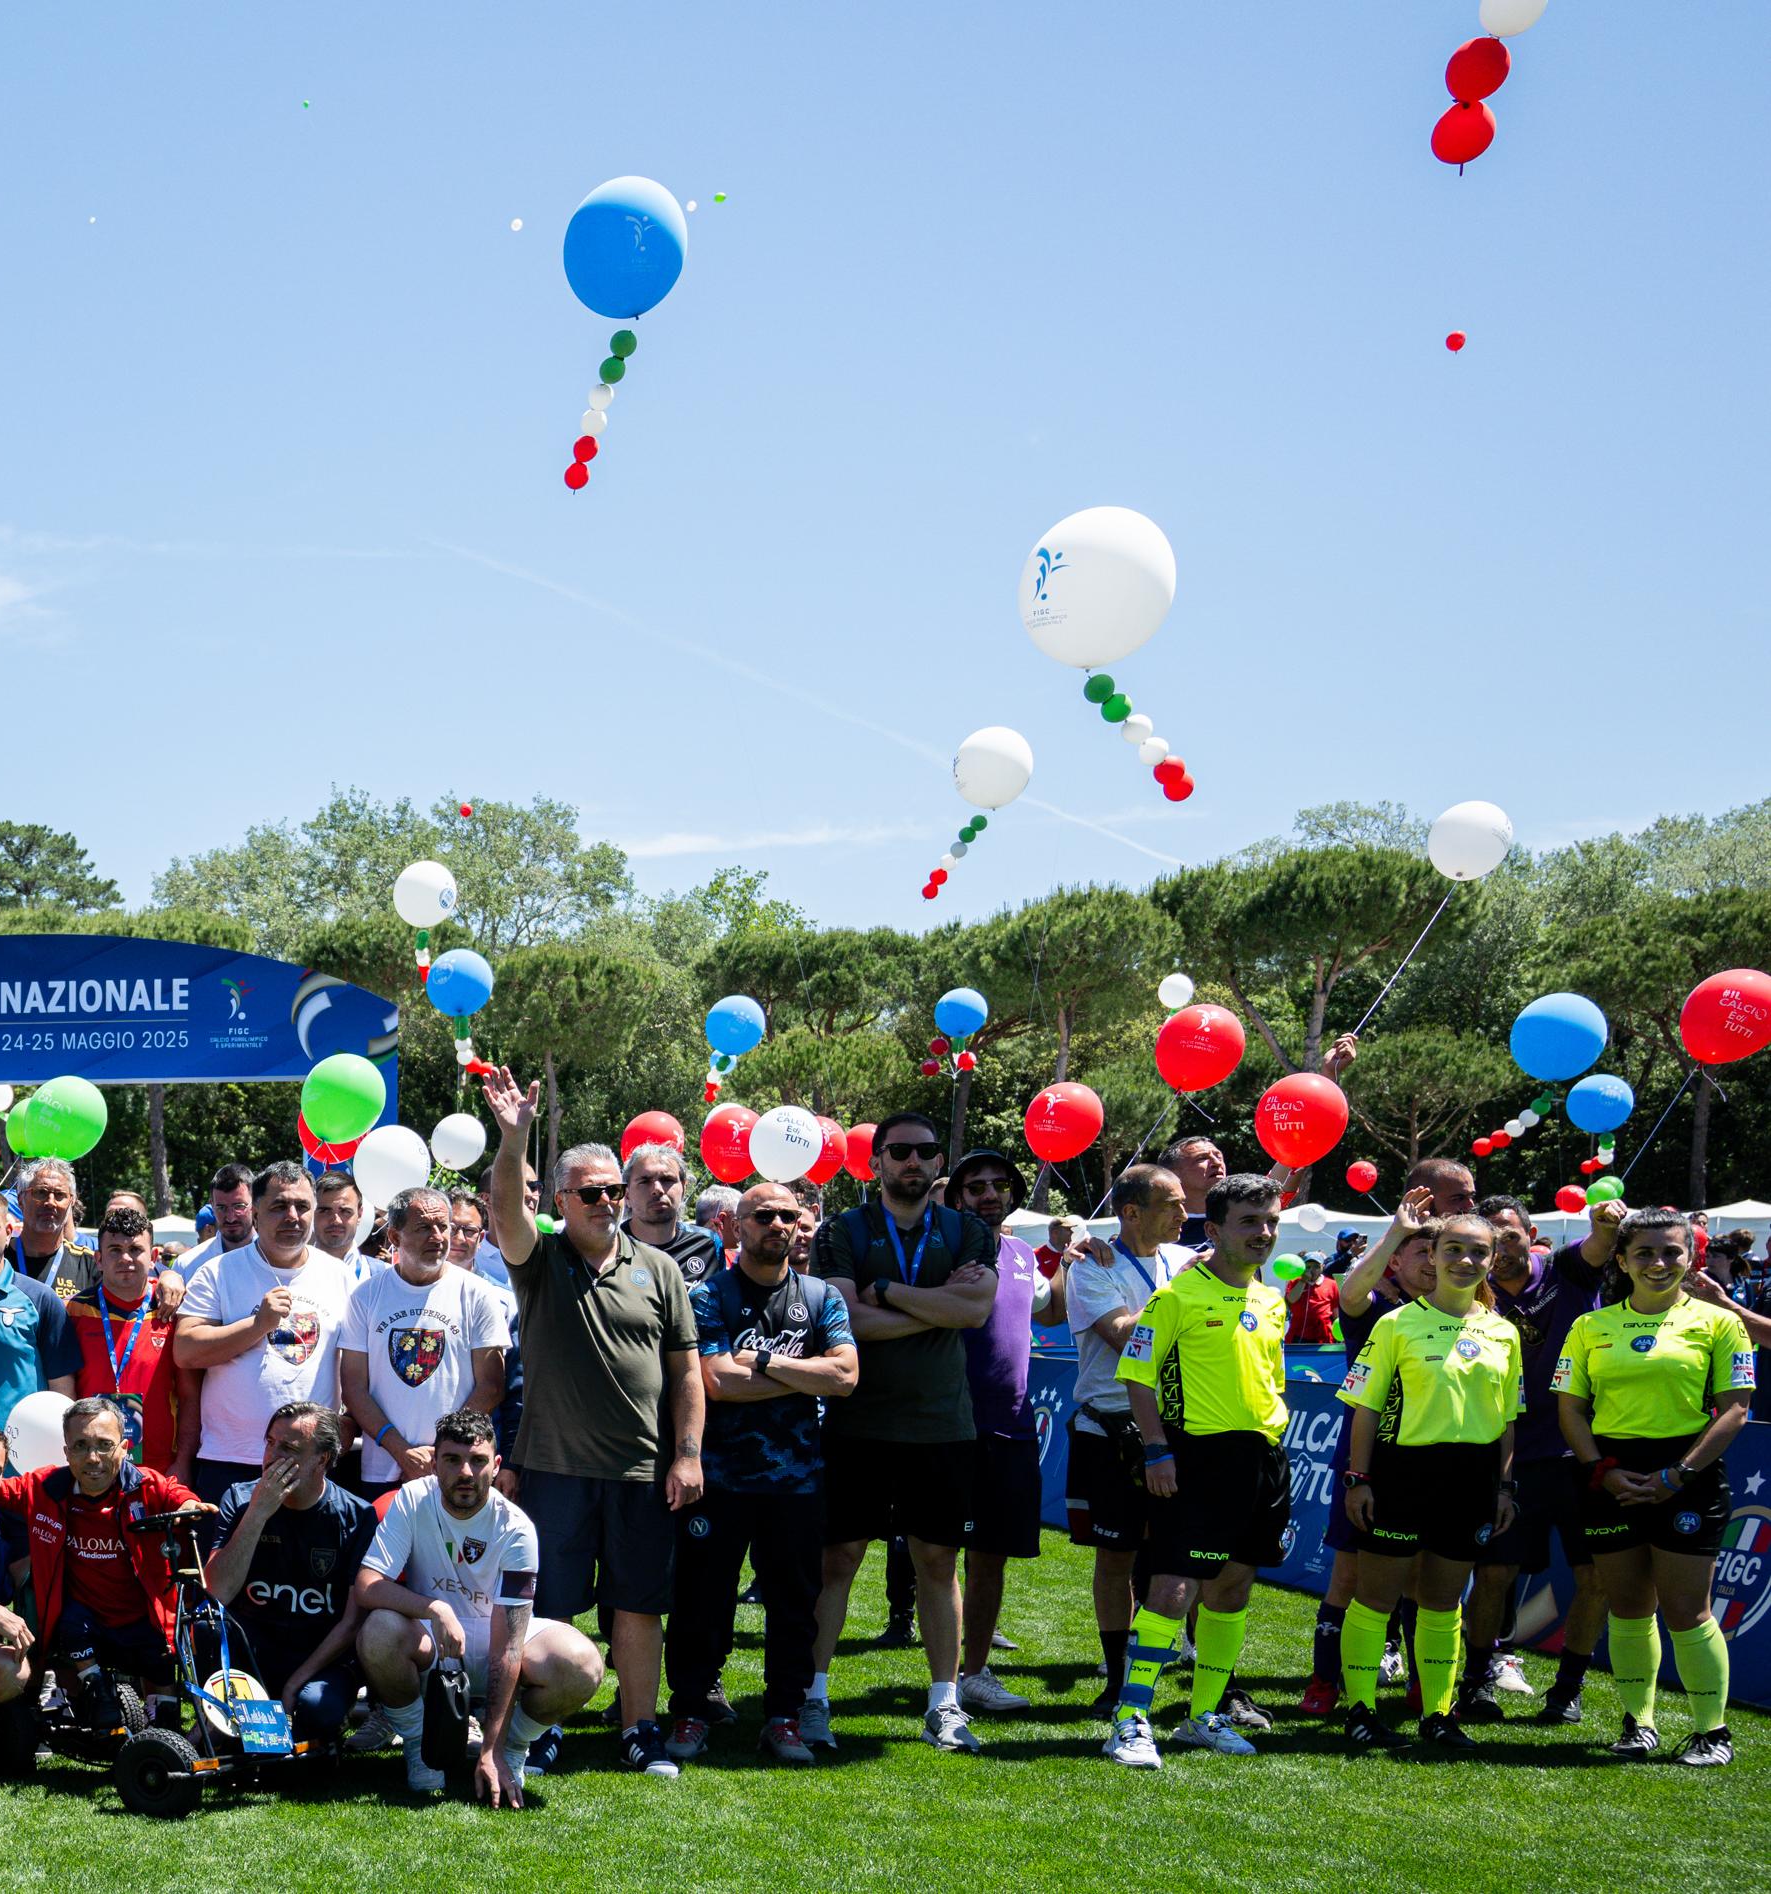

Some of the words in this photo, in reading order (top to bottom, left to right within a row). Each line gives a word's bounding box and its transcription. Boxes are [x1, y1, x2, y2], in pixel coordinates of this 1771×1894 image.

[0, 977, 190, 1014] NAZIONALE
[1722, 988, 1742, 1001] #IL
[1724, 1020, 1754, 1039] TUTTI
[2, 1032, 54, 1051] 24-25
[61, 1031, 135, 1050] MAGGIO
[141, 1029, 189, 1048] 2025
[1274, 1121, 1305, 1132] TUTTI
[784, 1133, 810, 1149] TUTTI
[56, 1277, 76, 1289] U.S.
[375, 1319, 390, 1335] WE
[388, 1310, 408, 1322] ARE
[409, 1308, 451, 1326] SUPERGA
[450, 1324, 460, 1336] 48
[1622, 1321, 1674, 1329] GIVOVA
[1135, 1325, 1154, 1339] ET
[1439, 1324, 1485, 1335] GIVOVA
[1557, 1358, 1571, 1370] ET
[1733, 1352, 1752, 1366] NE
[1350, 1362, 1371, 1377] ET
[1373, 1528, 1418, 1541] GIVOVA
[1189, 1550, 1230, 1561] GIVOVA
[1715, 1551, 1762, 1586] FIGC
[246, 1581, 334, 1614] enel
